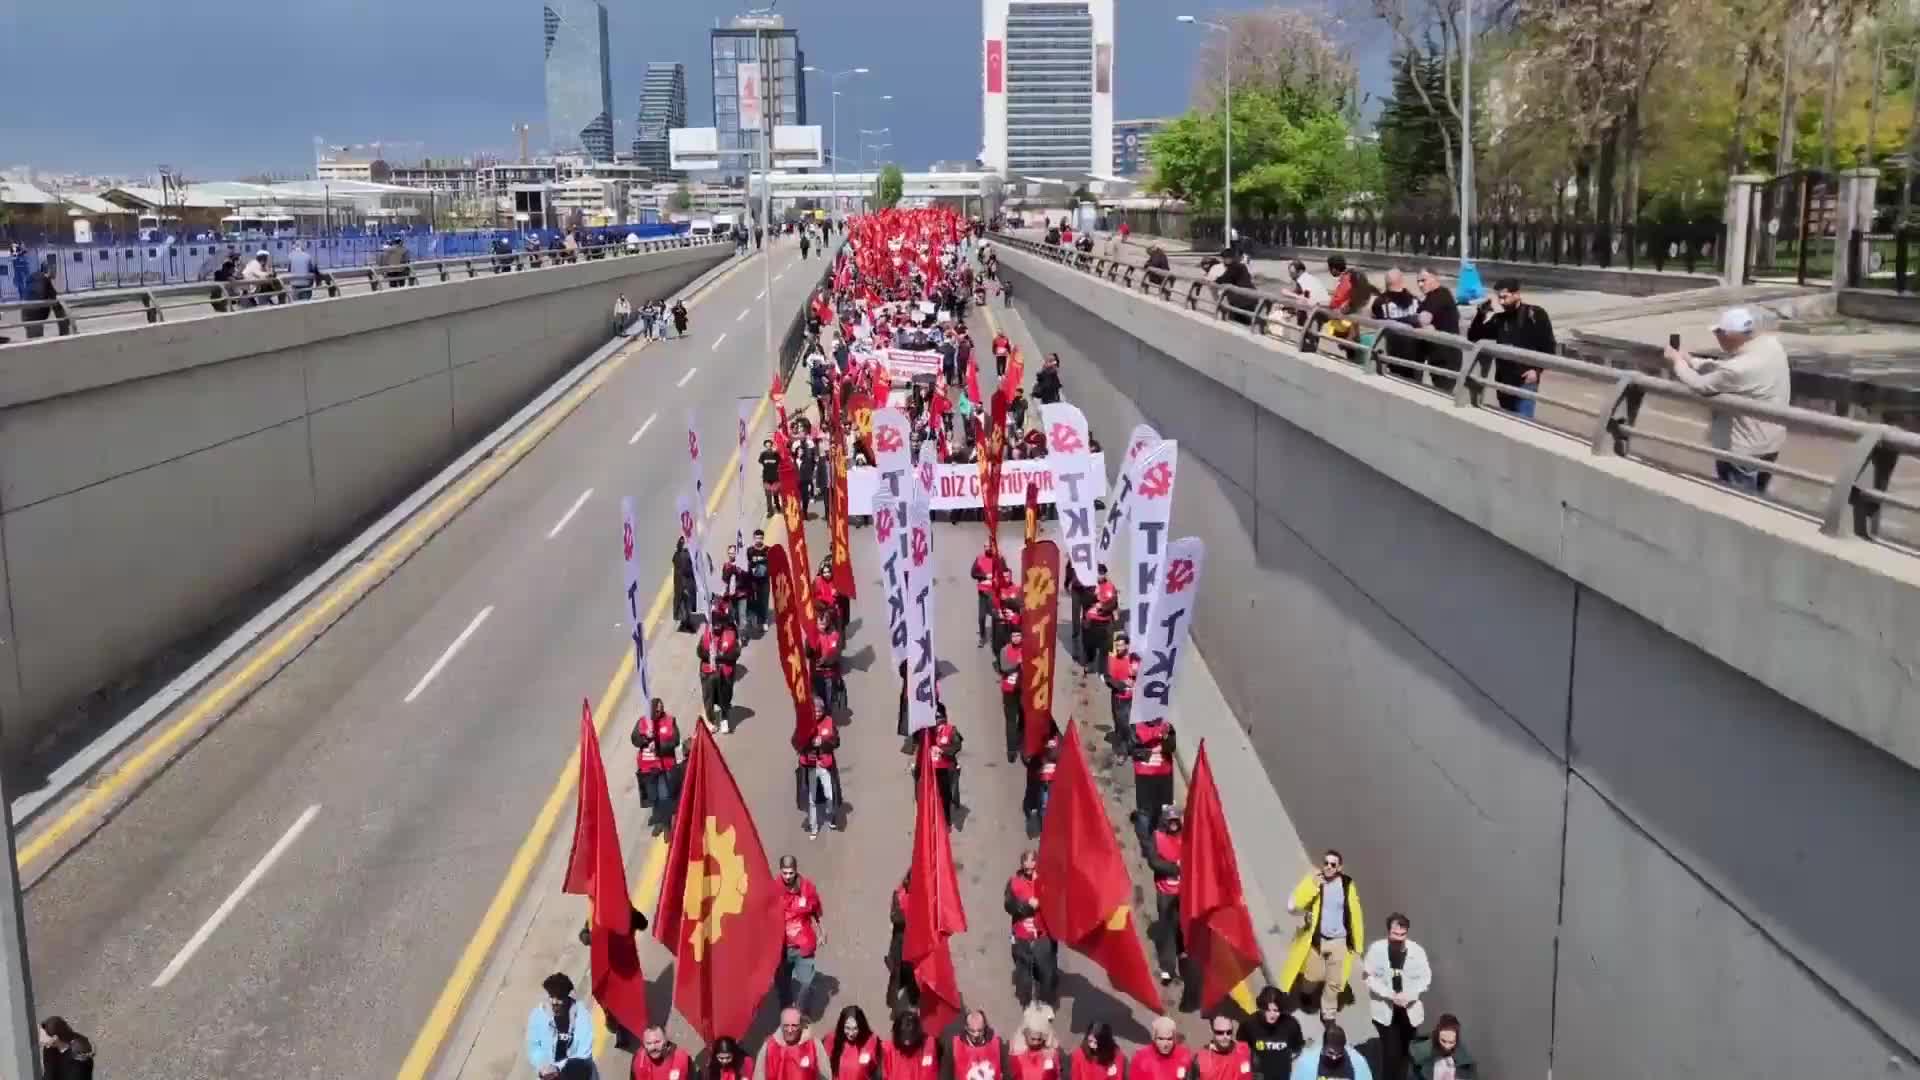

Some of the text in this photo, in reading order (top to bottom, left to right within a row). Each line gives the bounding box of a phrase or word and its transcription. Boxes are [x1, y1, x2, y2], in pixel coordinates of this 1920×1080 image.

[941, 471, 965, 498] DİZ
[1101, 473, 1133, 550] TKP
[1264, 1041, 1287, 1050] TKP
